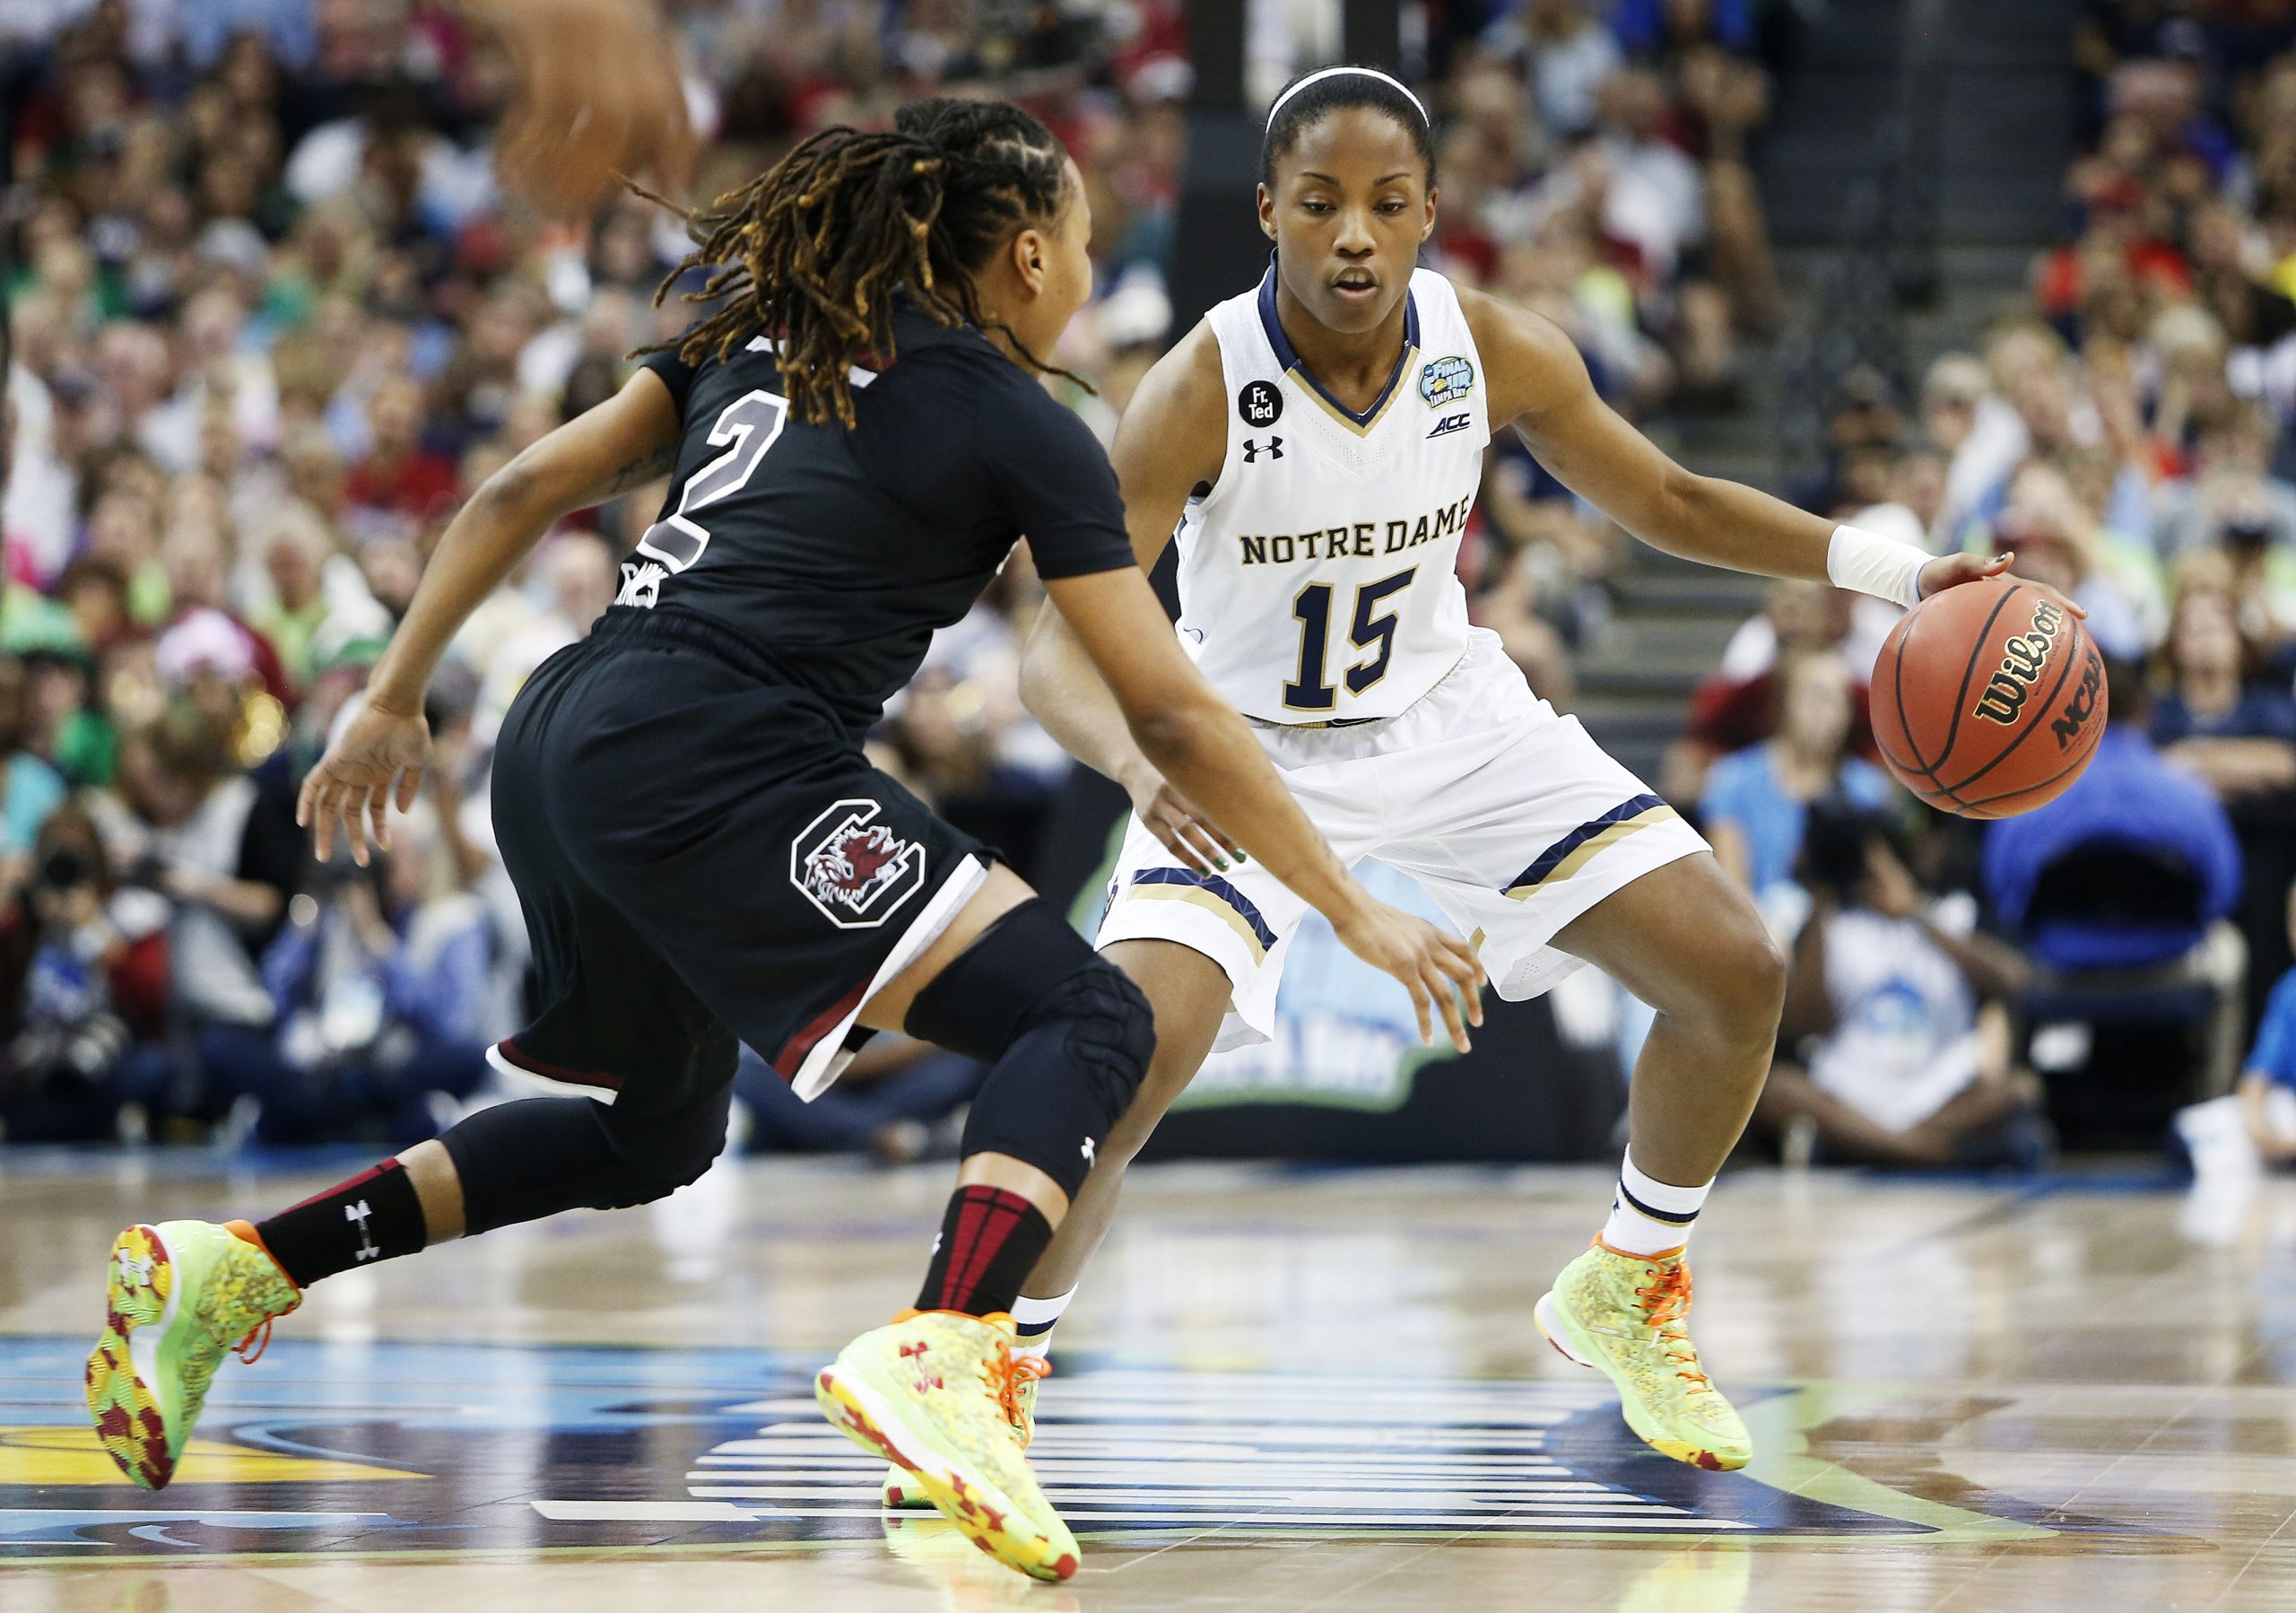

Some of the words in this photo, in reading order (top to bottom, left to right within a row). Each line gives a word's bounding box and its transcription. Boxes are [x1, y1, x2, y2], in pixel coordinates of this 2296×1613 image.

[1436, 358, 1470, 378] FINAL
[1252, 387, 1268, 404] Fr.
[1430, 389, 1452, 407] TAMPA
[1452, 387, 1466, 399] BAY
[1248, 402, 1274, 420] Ted
[1430, 413, 1470, 435] ACC
[636, 389, 789, 574] 2
[1240, 522, 1375, 566] NOTRE
[1383, 493, 1469, 555] DAME
[1282, 562, 1421, 711] 15
[1973, 599, 2063, 726] Wilson
